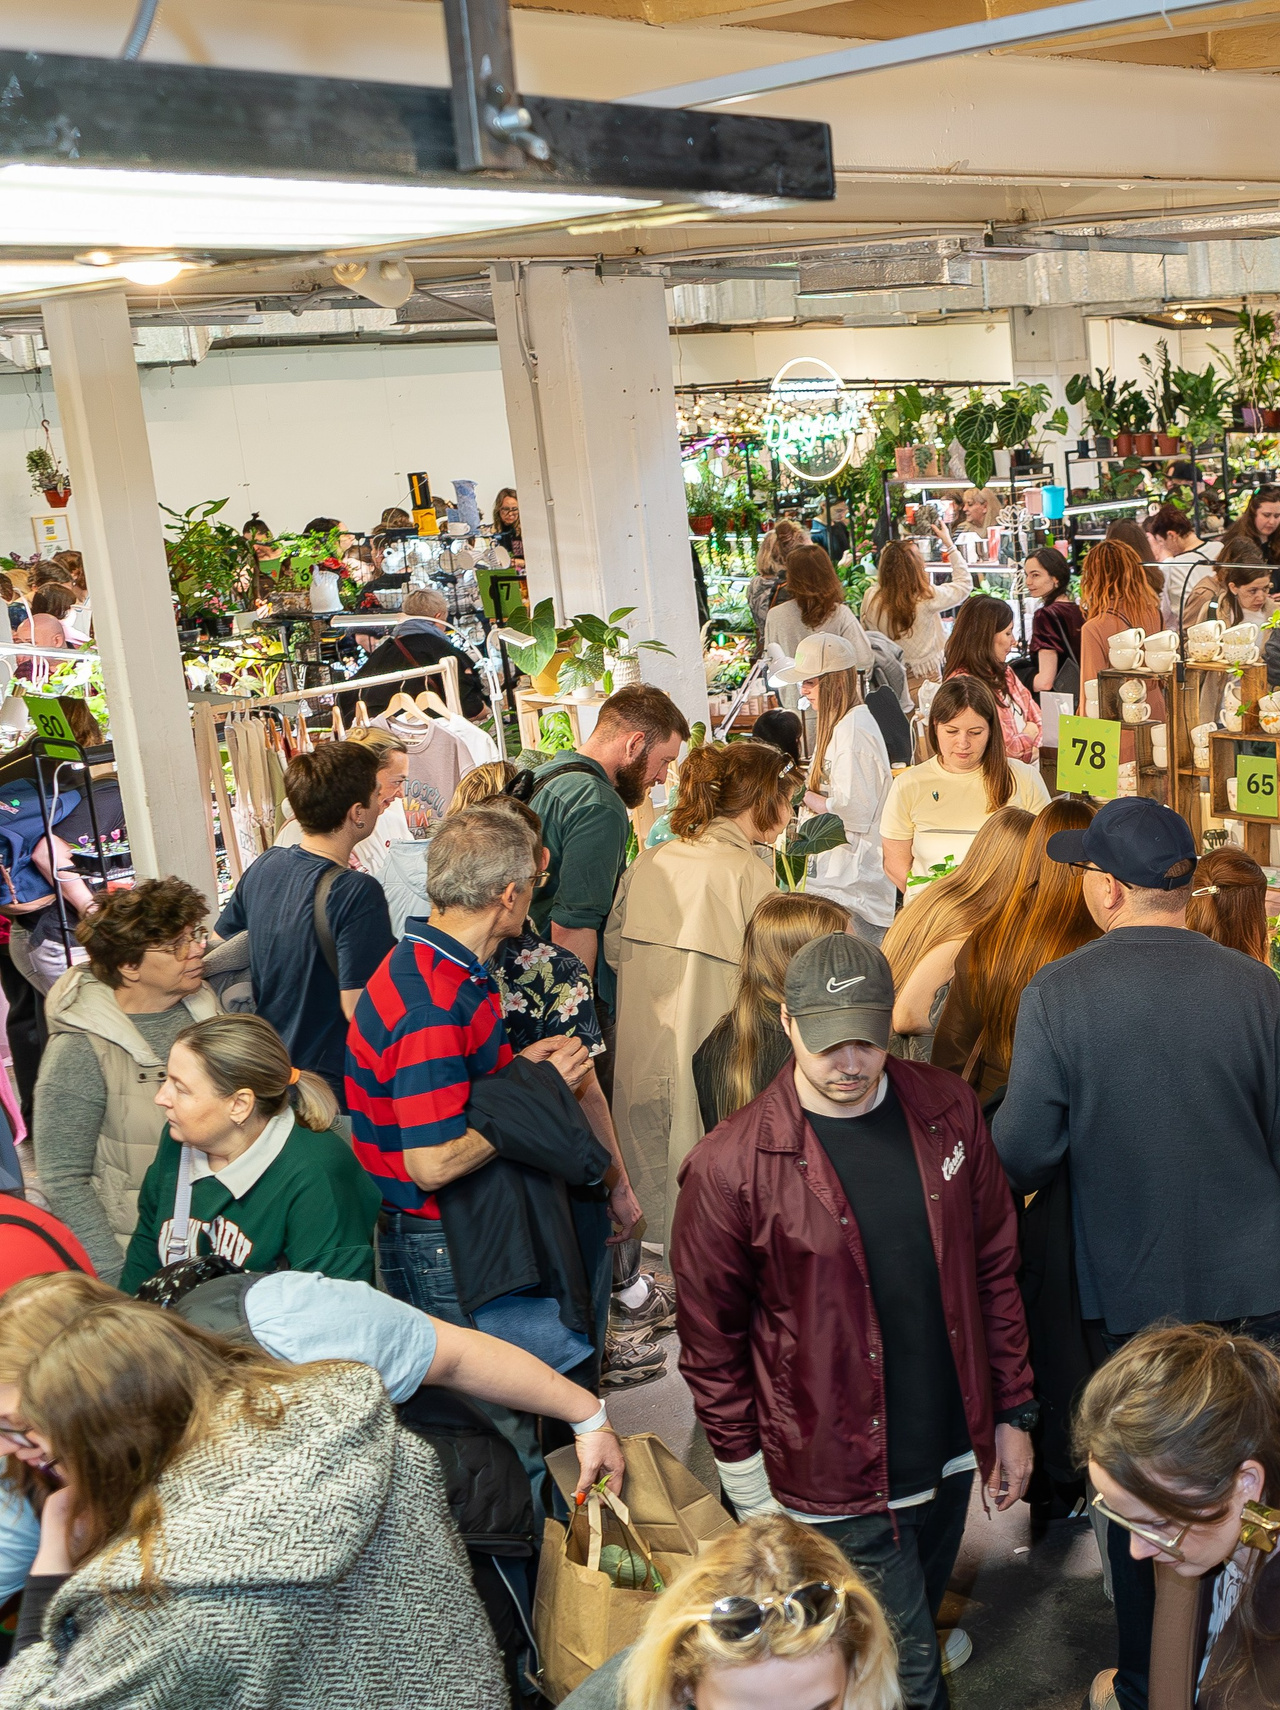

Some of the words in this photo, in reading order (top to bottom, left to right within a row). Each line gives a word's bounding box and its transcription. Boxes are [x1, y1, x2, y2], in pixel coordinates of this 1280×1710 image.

[38, 714, 66, 738] 80
[1071, 737, 1107, 770] 78
[1246, 772, 1275, 796] 65
